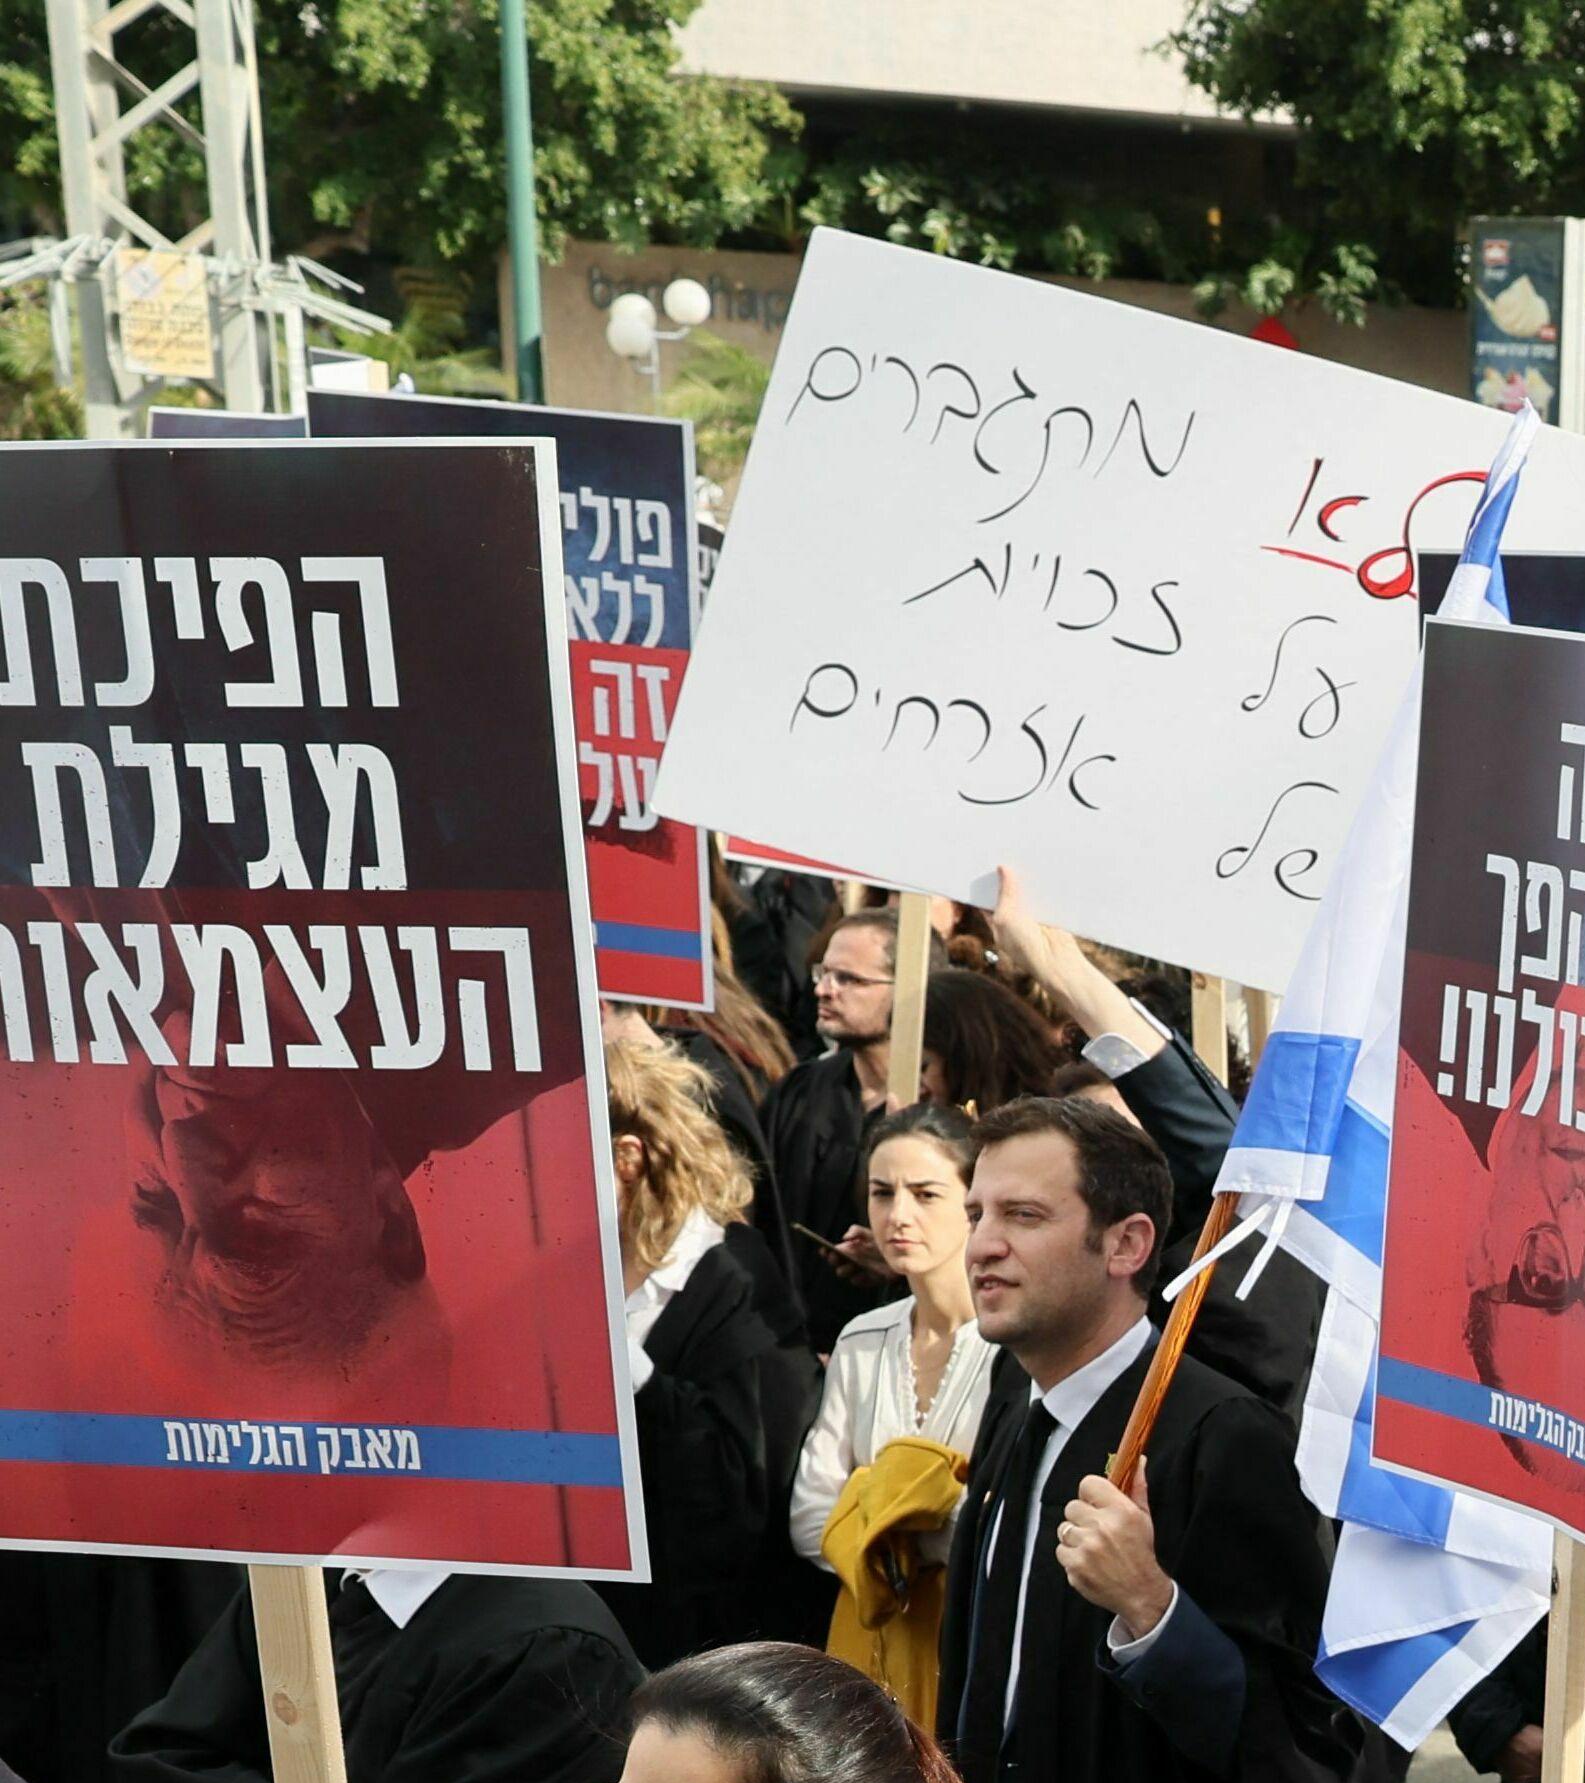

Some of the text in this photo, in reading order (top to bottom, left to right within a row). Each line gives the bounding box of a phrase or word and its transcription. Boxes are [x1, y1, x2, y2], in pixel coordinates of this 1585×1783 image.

[785, 346, 1489, 600] לא מתגברים
[590, 659, 671, 743] זה
[1240, 615, 1358, 739] על
[21, 725, 408, 891] מגילת
[789, 663, 1340, 900] של אזרחים
[163, 1420, 422, 1475] מאבק הגלימות
[1488, 1391, 1565, 1449] הגלימות
